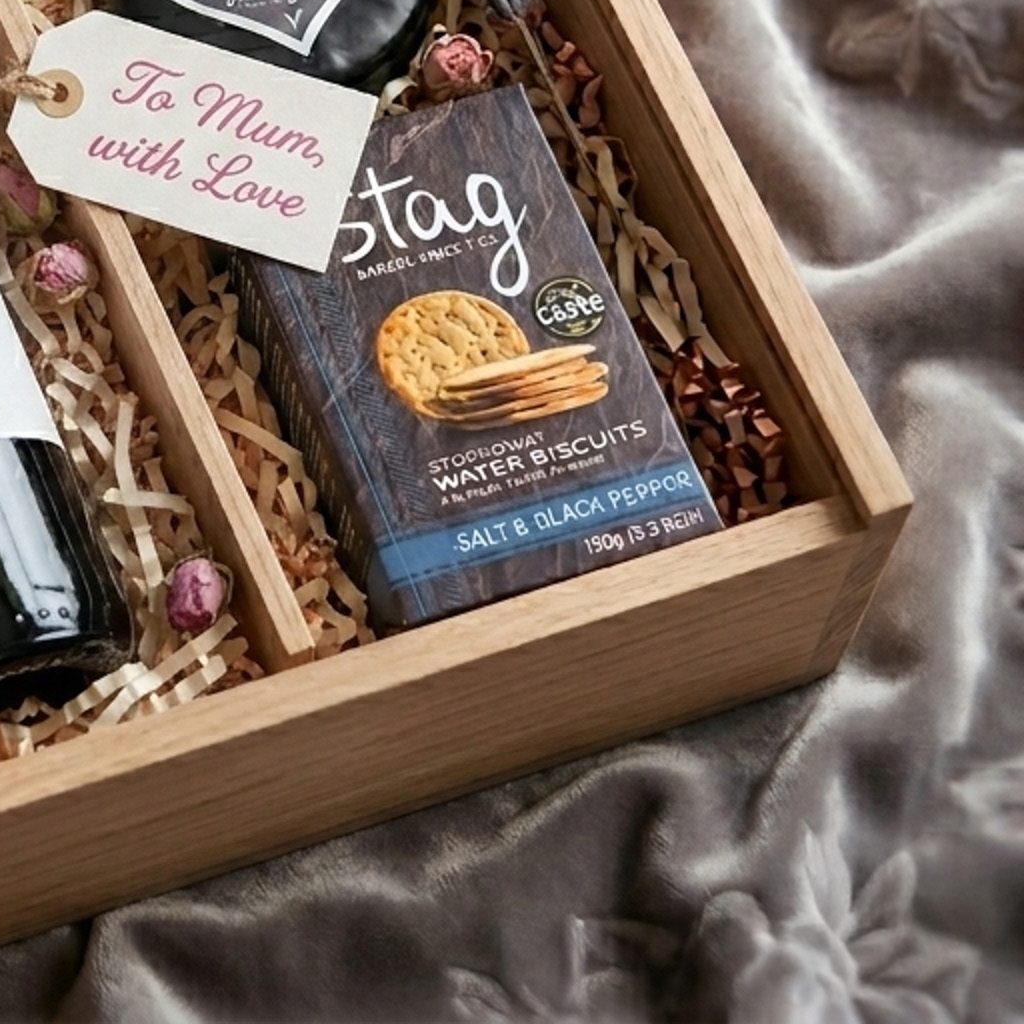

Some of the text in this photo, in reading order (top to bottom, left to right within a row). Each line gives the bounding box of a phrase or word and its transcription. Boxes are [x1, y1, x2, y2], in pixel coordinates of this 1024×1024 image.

[112, 60, 325, 169] To Mum,
[87, 135, 307, 218] with Love
[432, 455, 526, 492] WATER
[529, 419, 648, 465] BISCUITS
[456, 523, 512, 553] SALT
